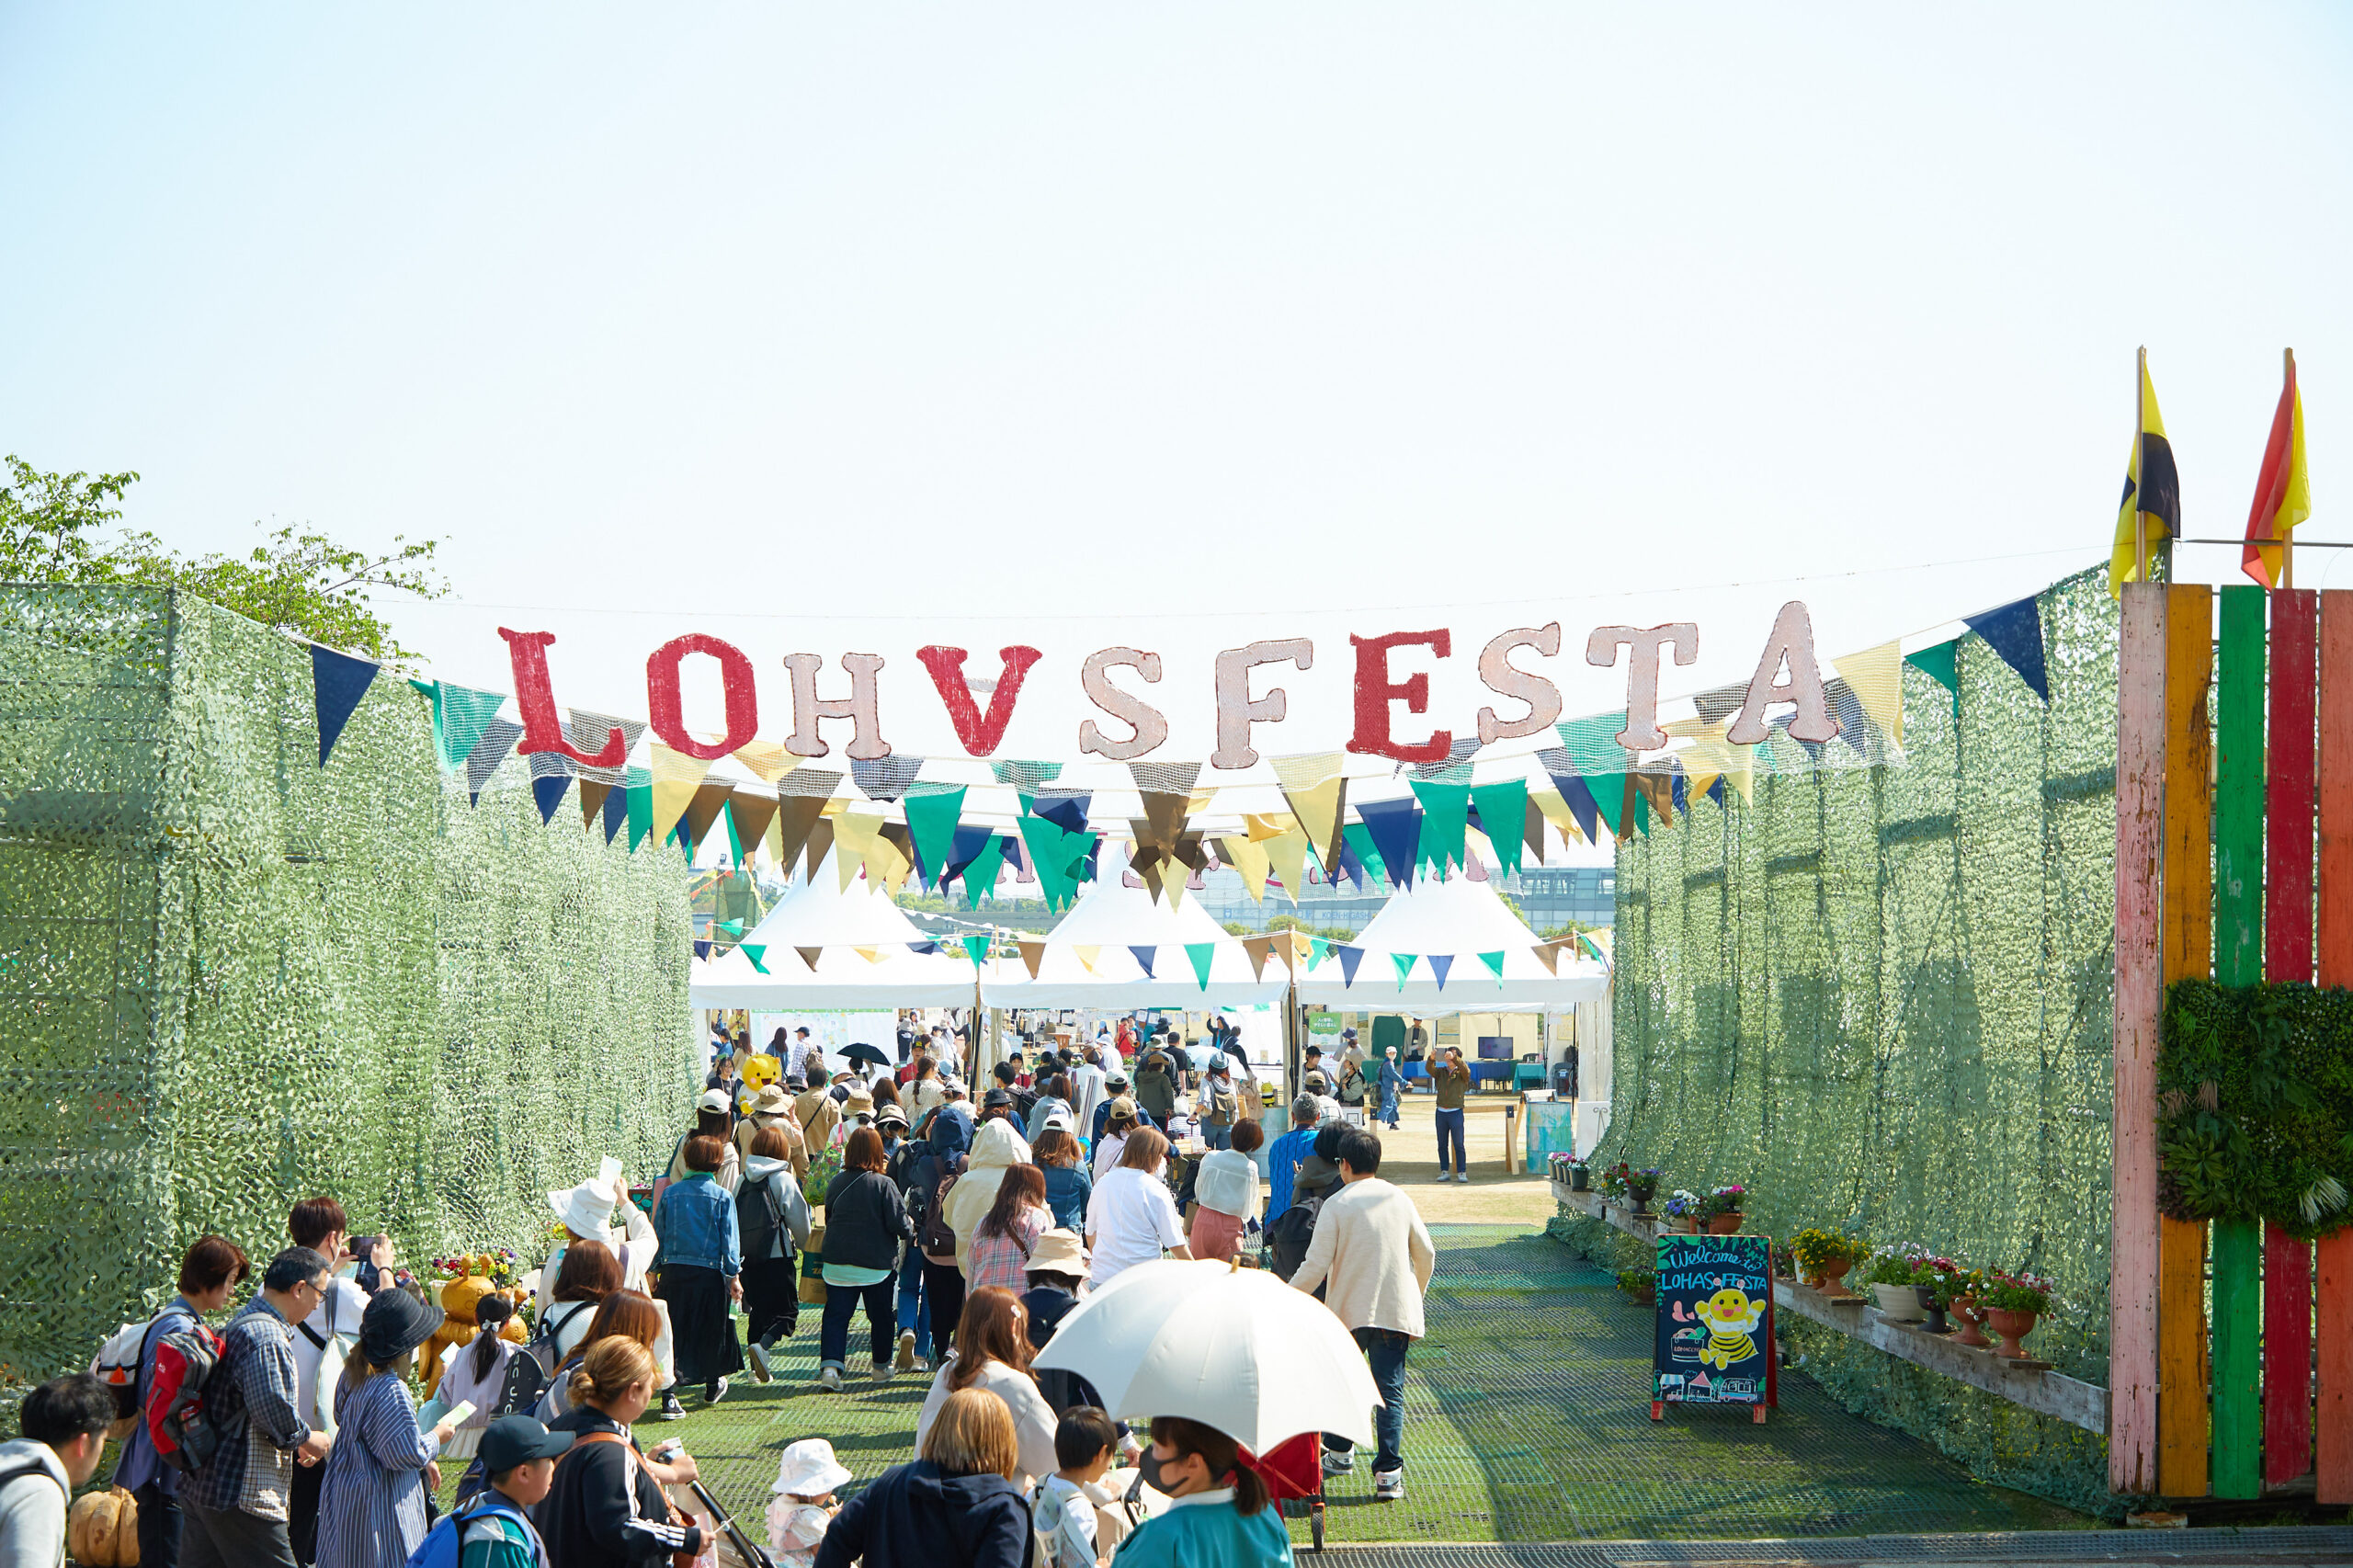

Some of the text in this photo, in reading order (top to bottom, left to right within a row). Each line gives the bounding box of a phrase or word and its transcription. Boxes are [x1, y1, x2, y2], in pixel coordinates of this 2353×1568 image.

[1670, 1245, 1762, 1271] Welcome to
[1661, 1271, 1768, 1290] LOHAS FESTA
